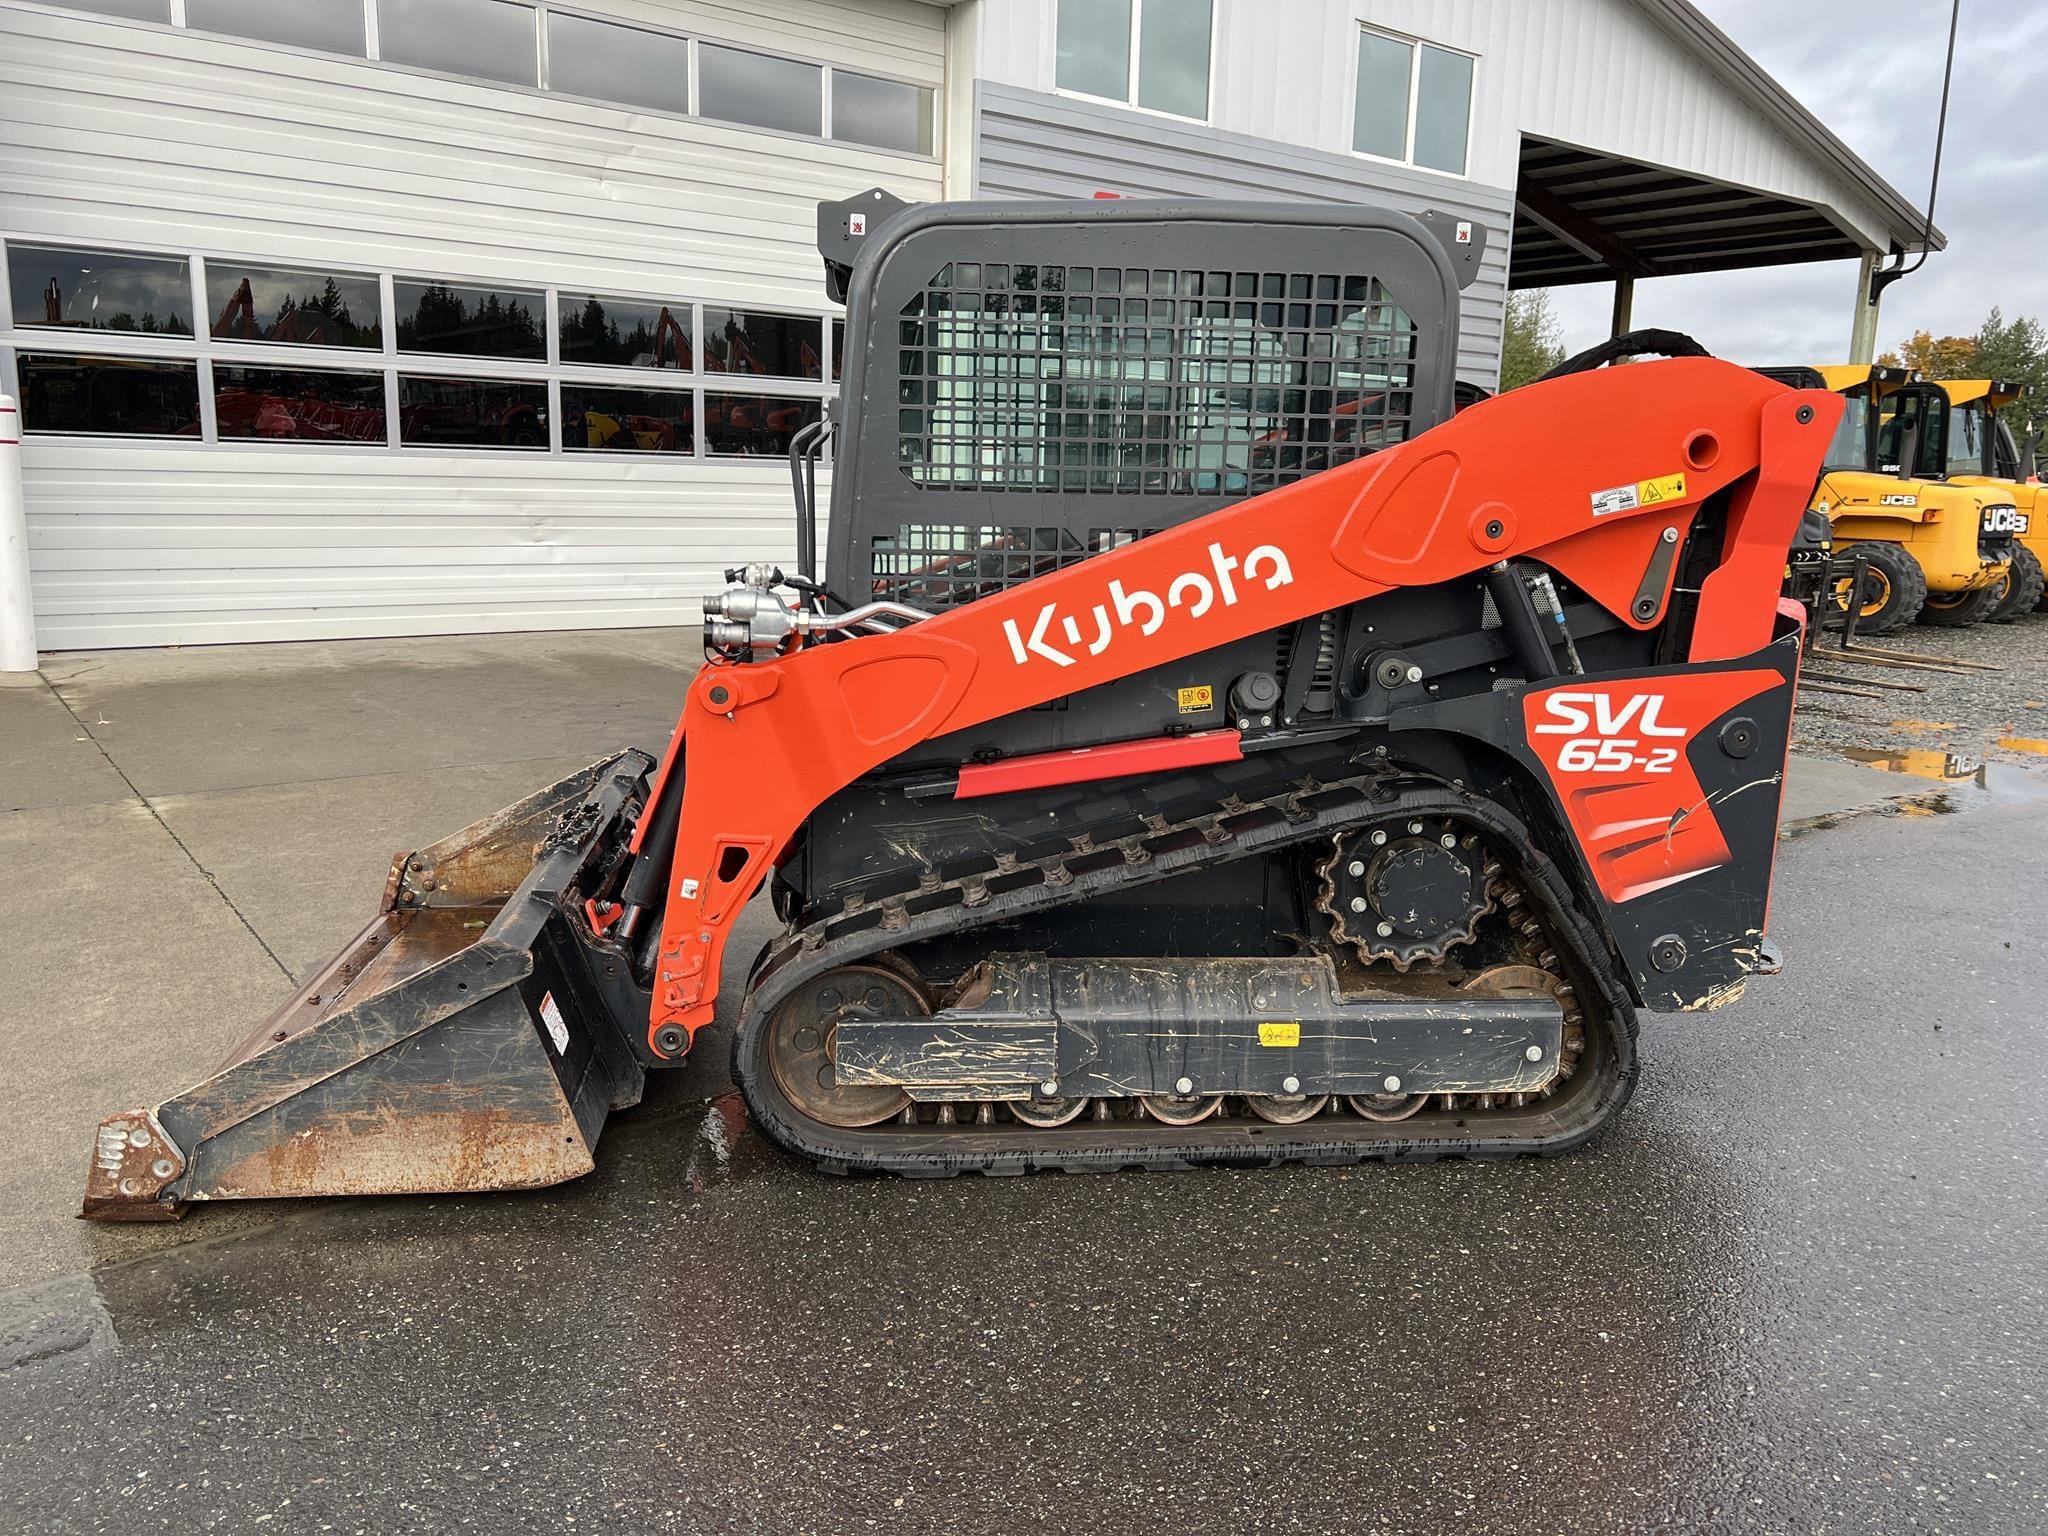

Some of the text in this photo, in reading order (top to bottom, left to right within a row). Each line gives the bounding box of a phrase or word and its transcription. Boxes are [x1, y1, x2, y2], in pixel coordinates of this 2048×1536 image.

[1880, 495, 1916, 506] JCB
[1984, 508, 2016, 532] JCB
[1003, 543, 1294, 666] Kubota
[1535, 692, 1687, 737] SVL
[1557, 739, 1678, 773] 65-2
